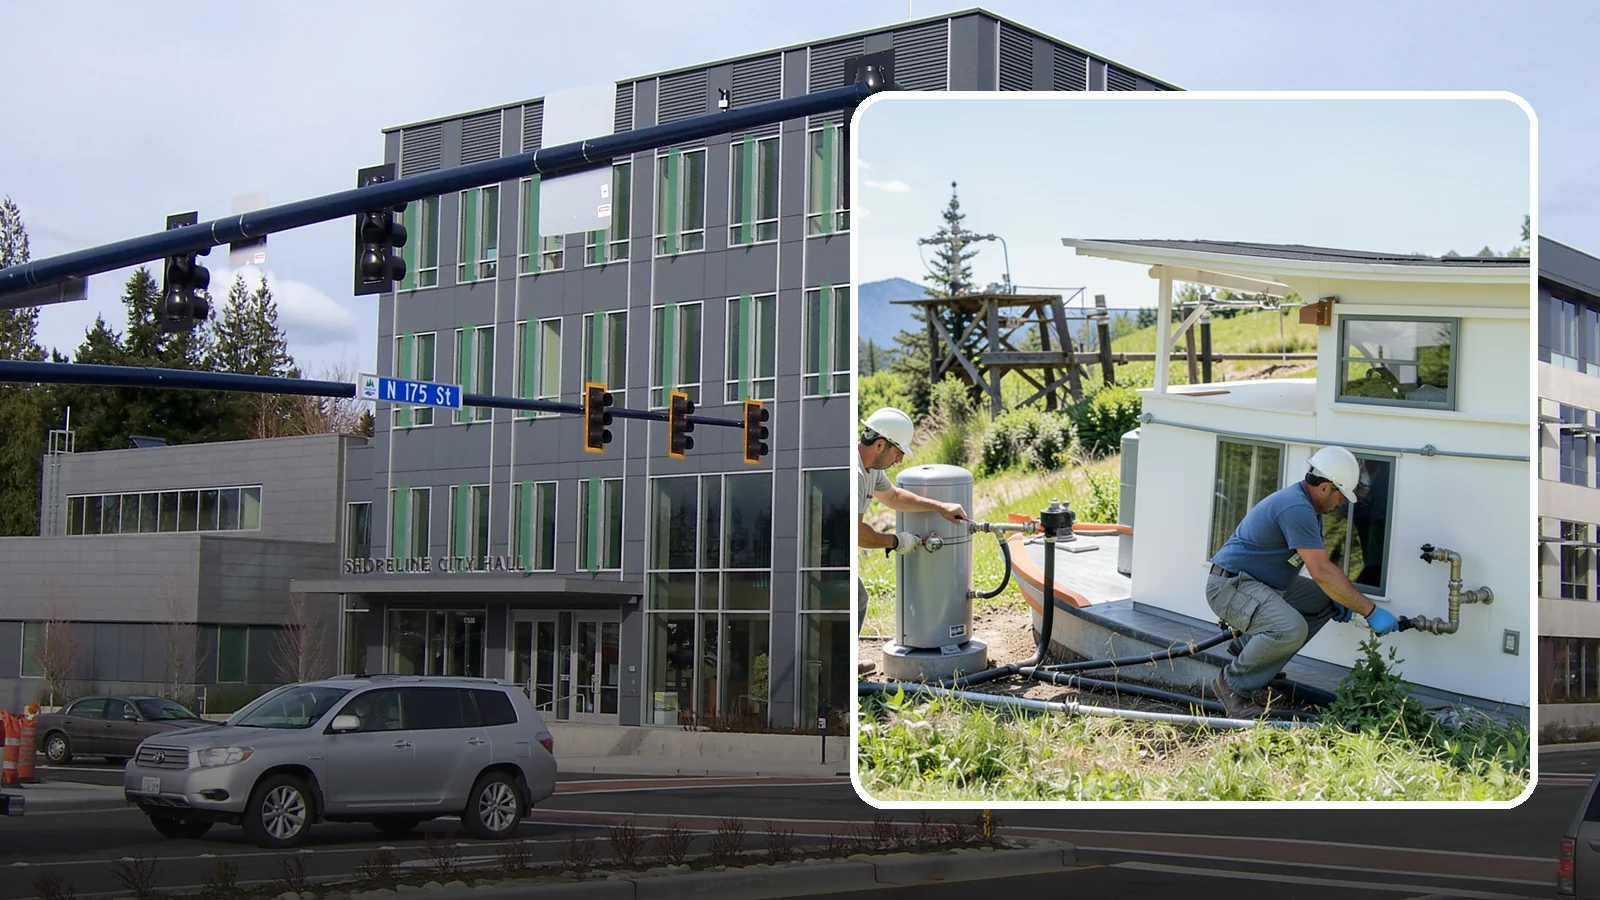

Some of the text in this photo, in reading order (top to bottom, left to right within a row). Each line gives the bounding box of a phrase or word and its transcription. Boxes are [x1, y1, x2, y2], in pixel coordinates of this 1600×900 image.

[387, 380, 452, 406] N 175 St
[344, 555, 526, 574] SHORELINE CITY HALL
